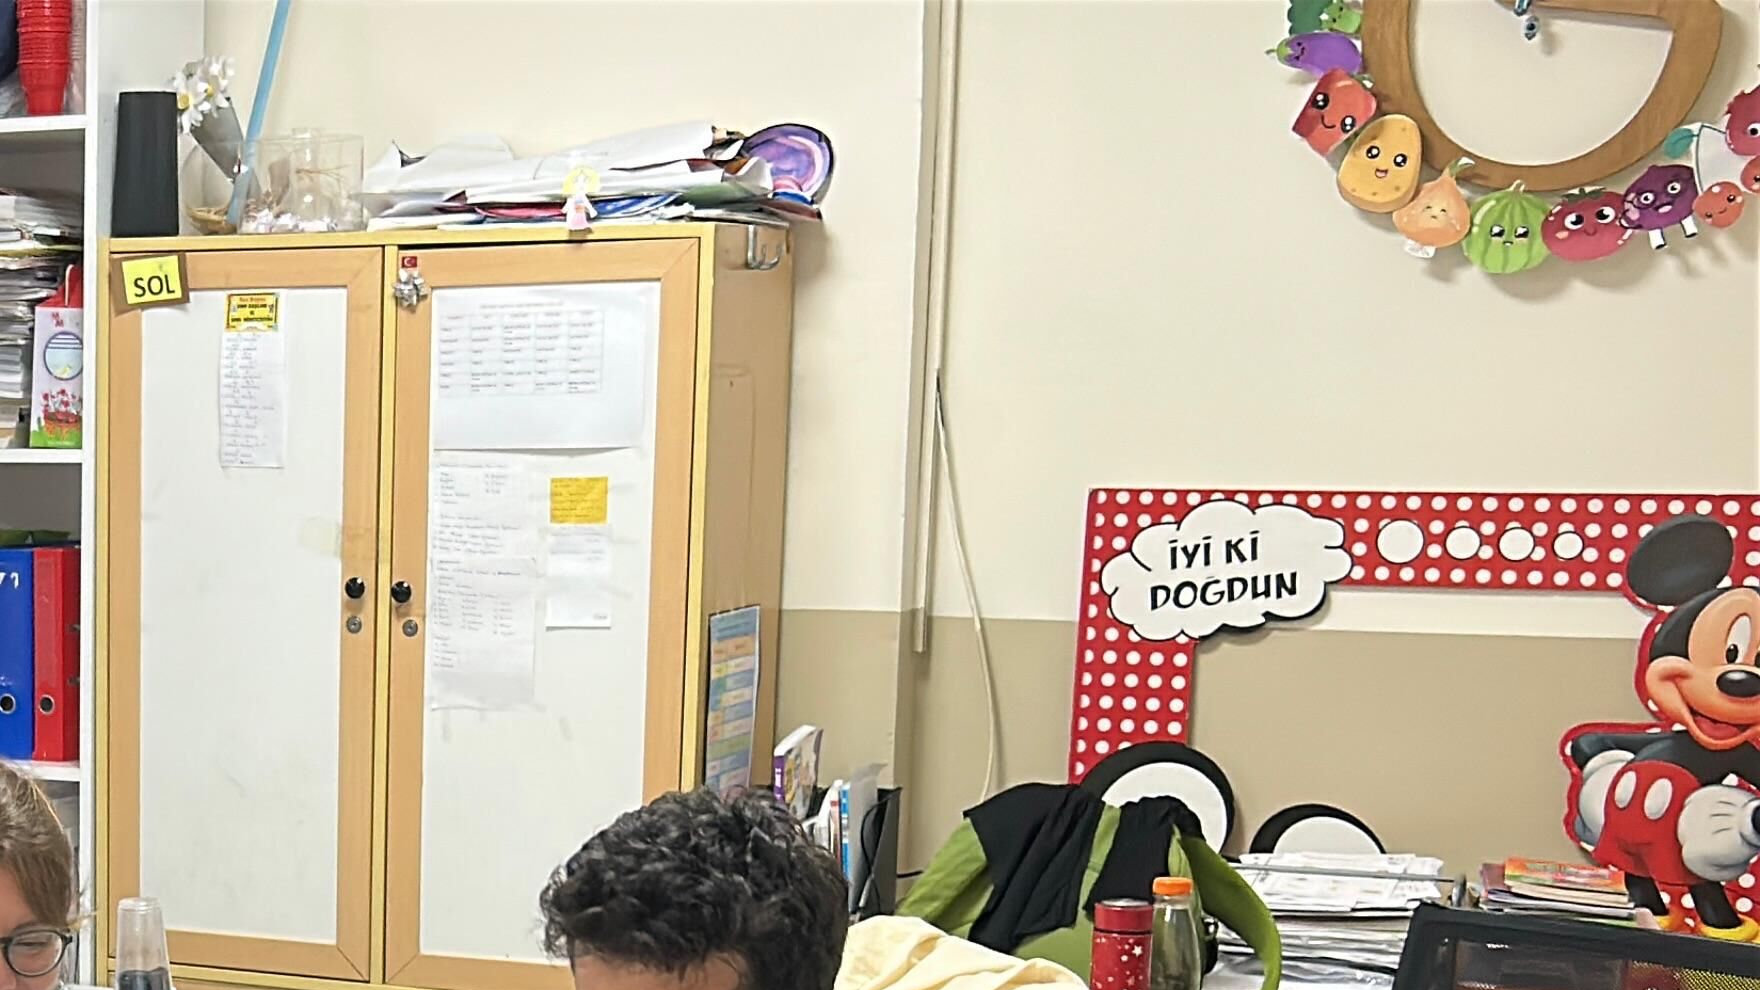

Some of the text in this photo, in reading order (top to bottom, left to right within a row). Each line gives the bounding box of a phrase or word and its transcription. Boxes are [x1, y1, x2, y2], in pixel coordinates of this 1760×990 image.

[133, 274, 176, 298] SOL
[1168, 530, 1261, 570] İYİ Kİ
[1150, 571, 1298, 612] DOĞDUN
